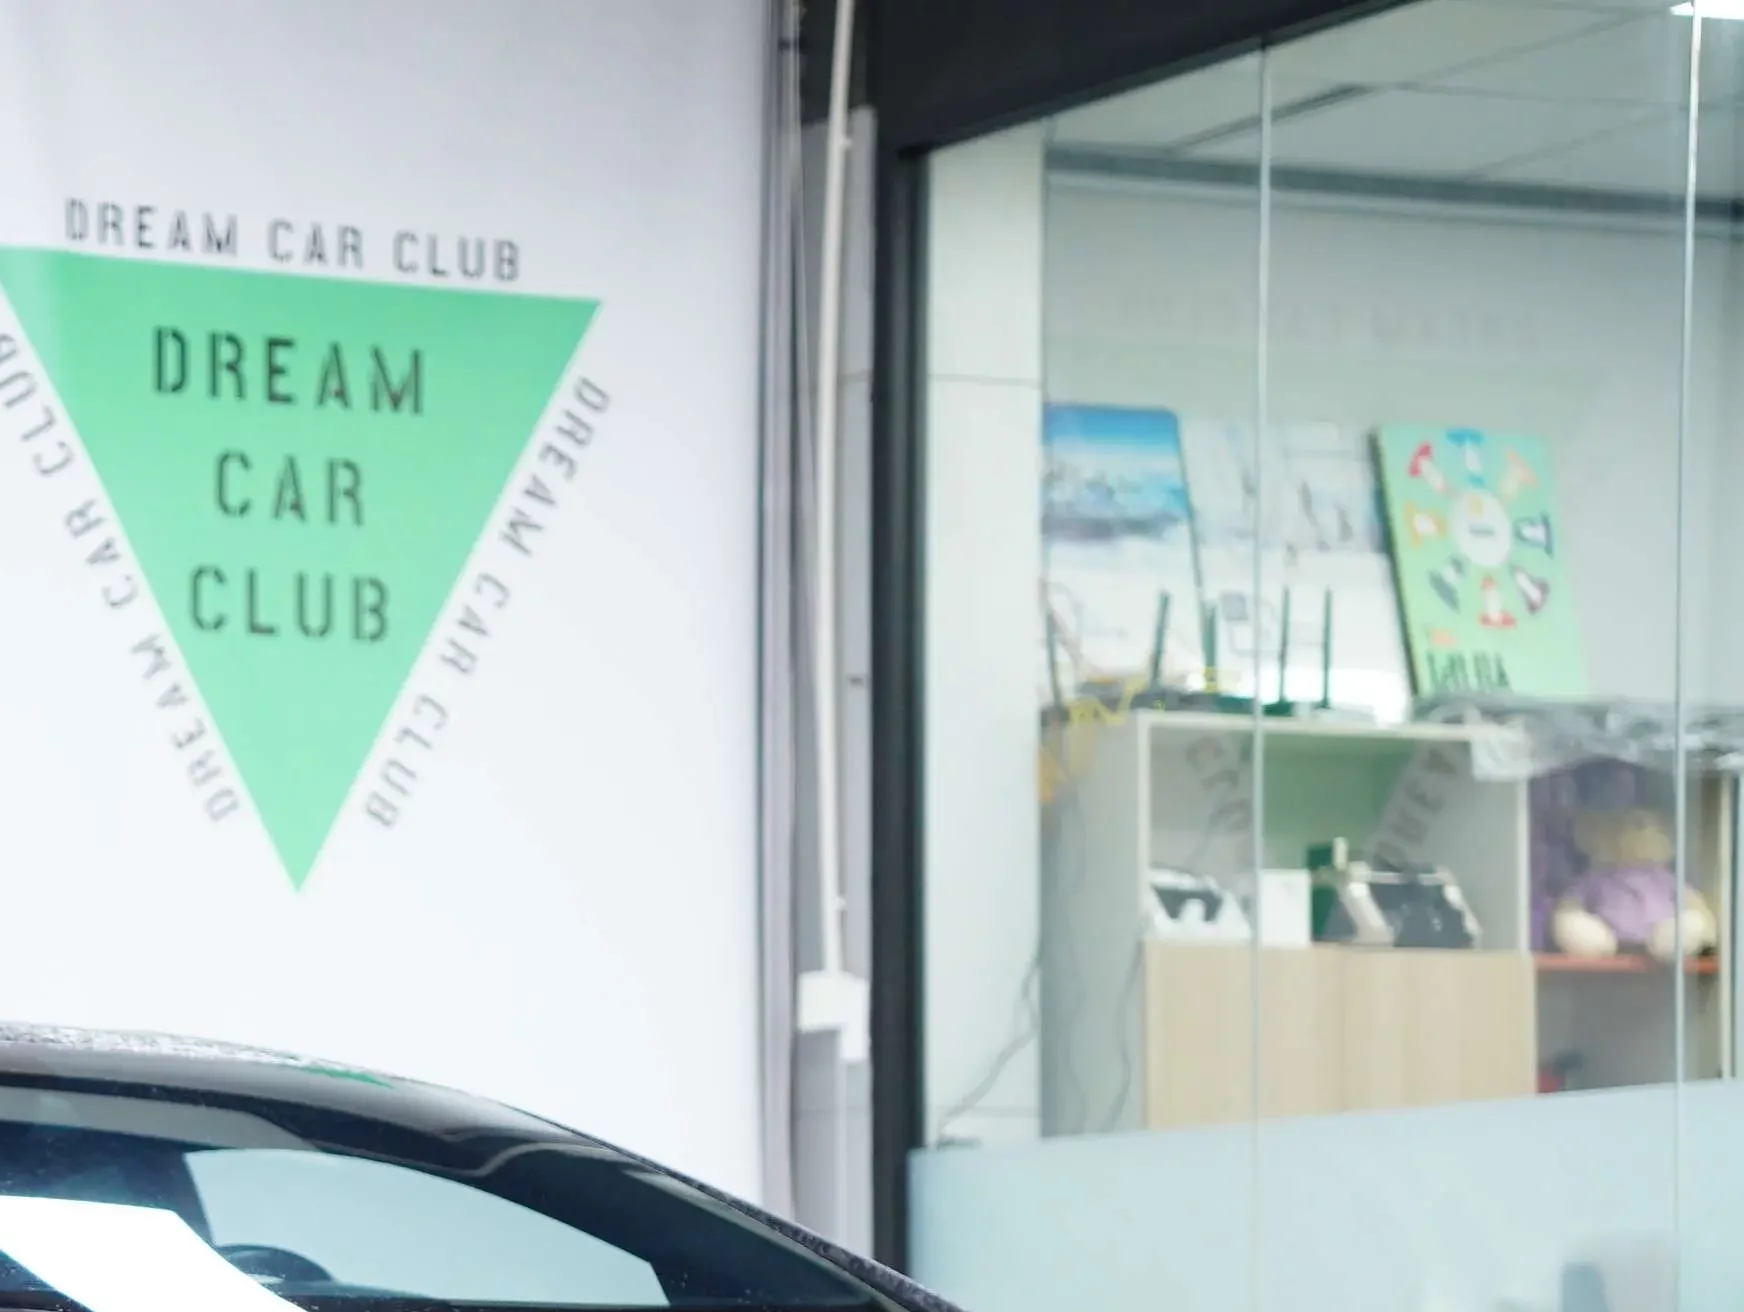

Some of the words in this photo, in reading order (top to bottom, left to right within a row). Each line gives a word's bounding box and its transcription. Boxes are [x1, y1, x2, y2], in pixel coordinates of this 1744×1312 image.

[64, 197, 239, 258] DREAM
[266, 218, 365, 269] CAR
[393, 231, 521, 282] CLUB
[153, 325, 425, 417] DREAM
[215, 448, 365, 527] CAR
[499, 376, 610, 557] DREAM
[63, 496, 141, 611] CAR
[190, 564, 391, 645] CLUB
[440, 571, 512, 677] CAR
[129, 633, 240, 823] DREAM
[364, 692, 450, 829] CLUB
